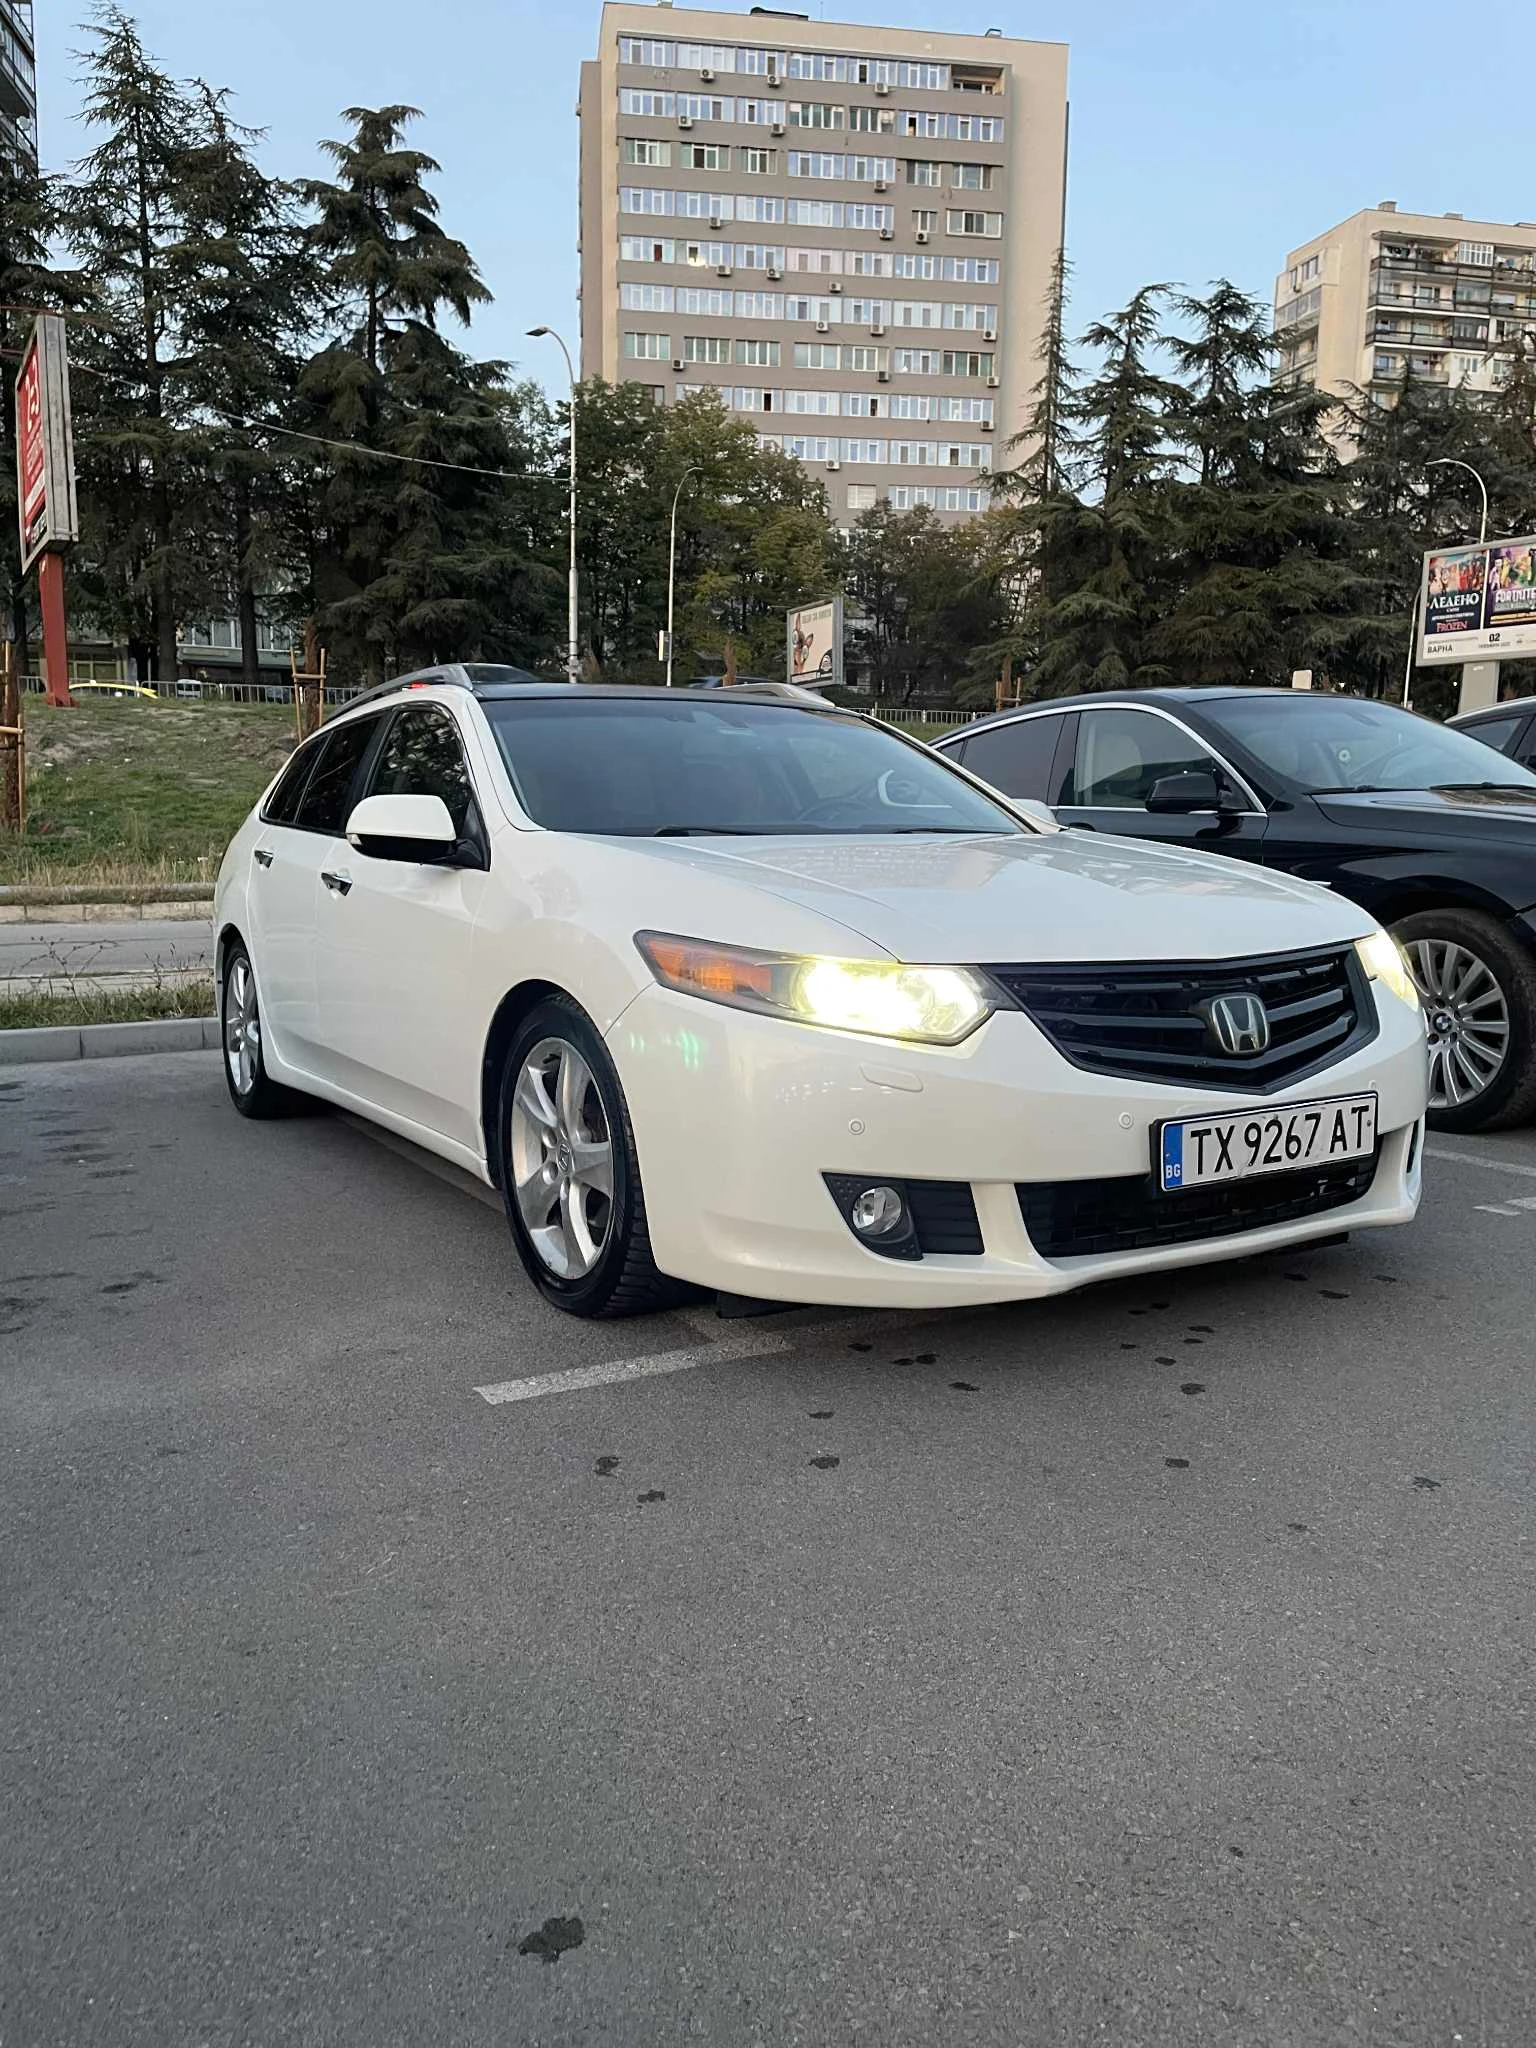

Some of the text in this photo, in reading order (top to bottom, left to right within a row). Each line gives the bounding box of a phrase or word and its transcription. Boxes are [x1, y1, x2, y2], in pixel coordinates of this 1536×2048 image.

[1437, 621, 1468, 632] FROZEN
[1489, 633, 1501, 642] 02
[1427, 644, 1453, 654] ВАРНА
[1190, 1104, 1370, 1176] TX 9267 AT
[1165, 1164, 1181, 1179] BG
